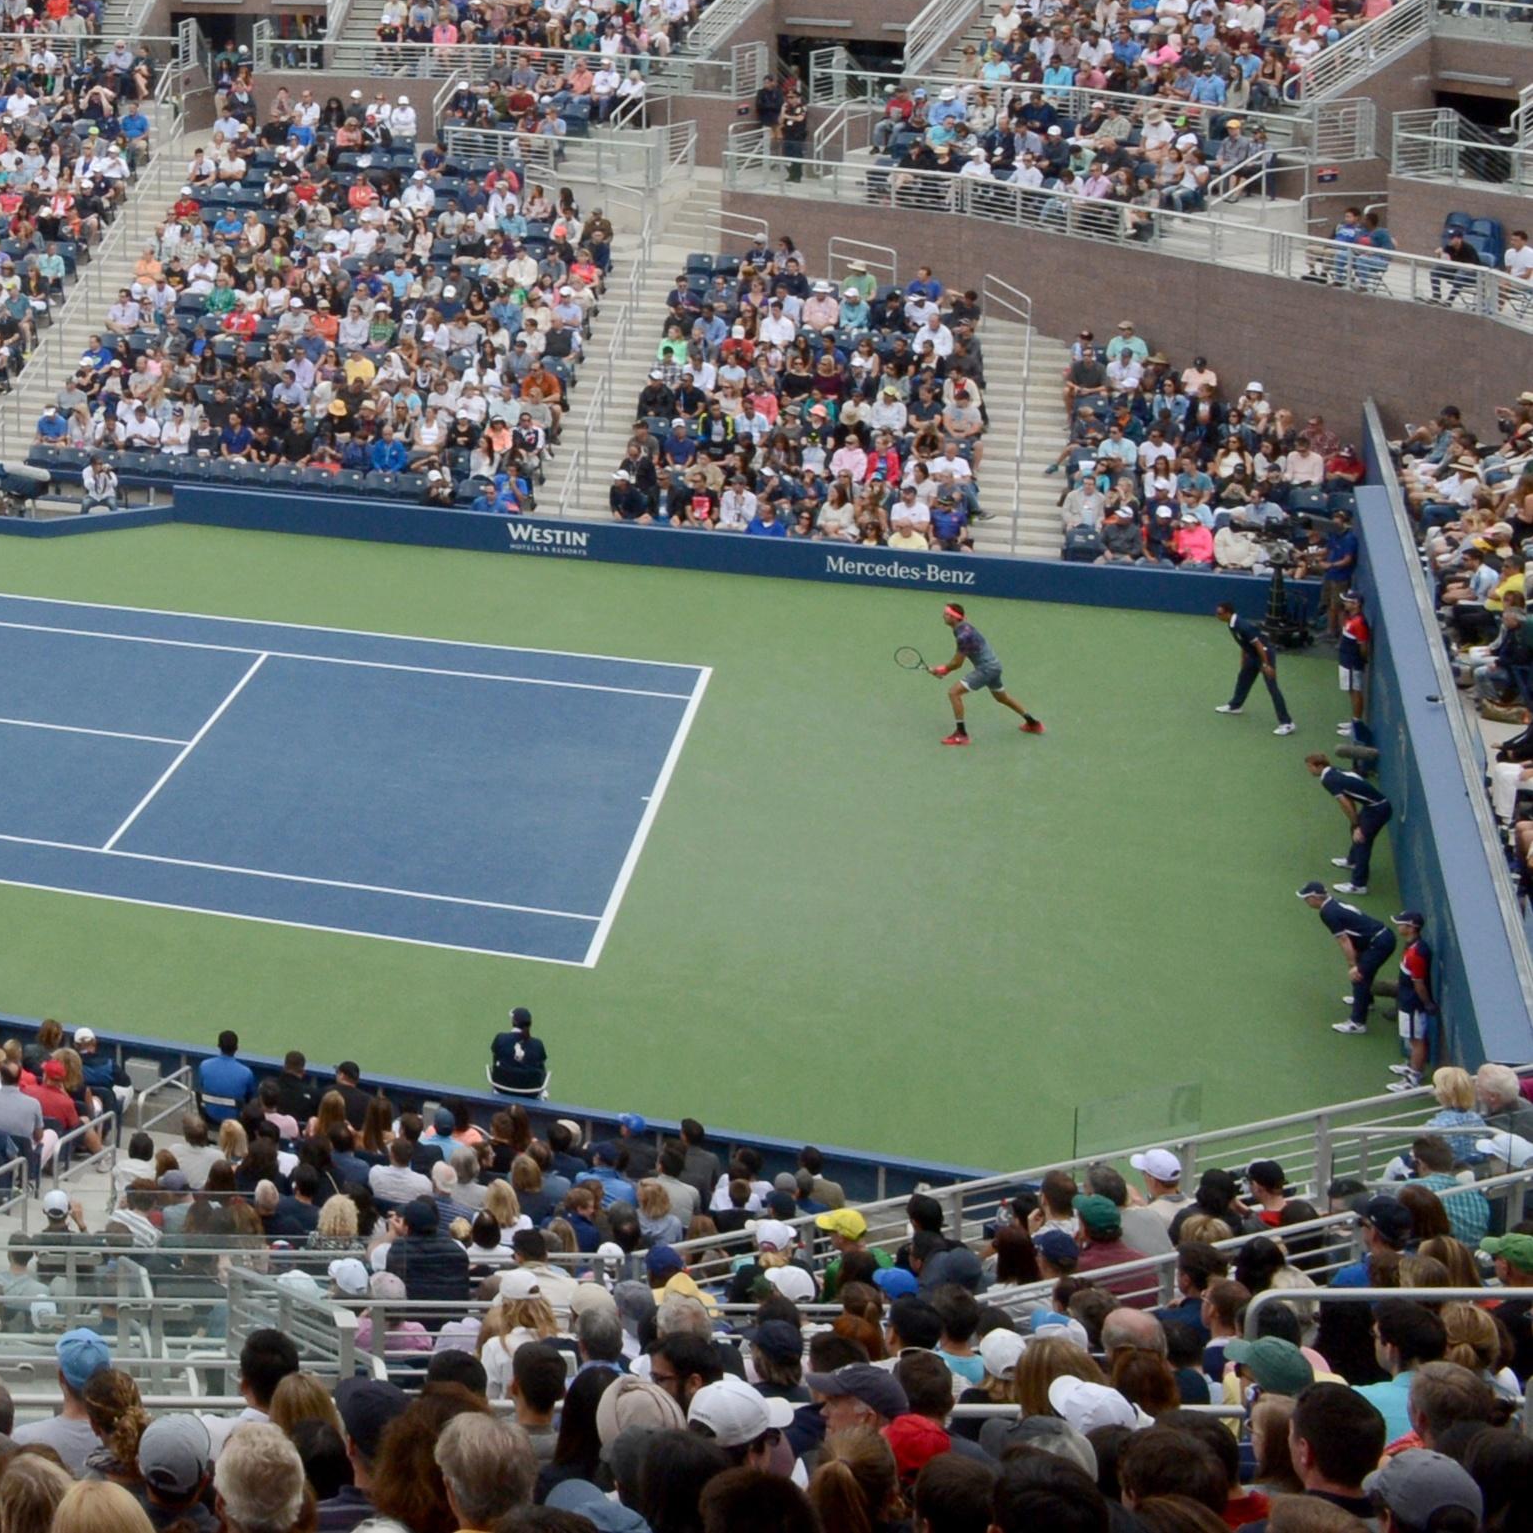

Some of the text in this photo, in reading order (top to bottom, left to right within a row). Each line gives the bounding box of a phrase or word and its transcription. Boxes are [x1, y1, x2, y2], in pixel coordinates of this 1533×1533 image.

[507, 522, 587, 546] WESTIN
[509, 543, 540, 553] HOTELS
[551, 547, 587, 556] RESORTS
[826, 555, 976, 585] Mercedes-Benz
